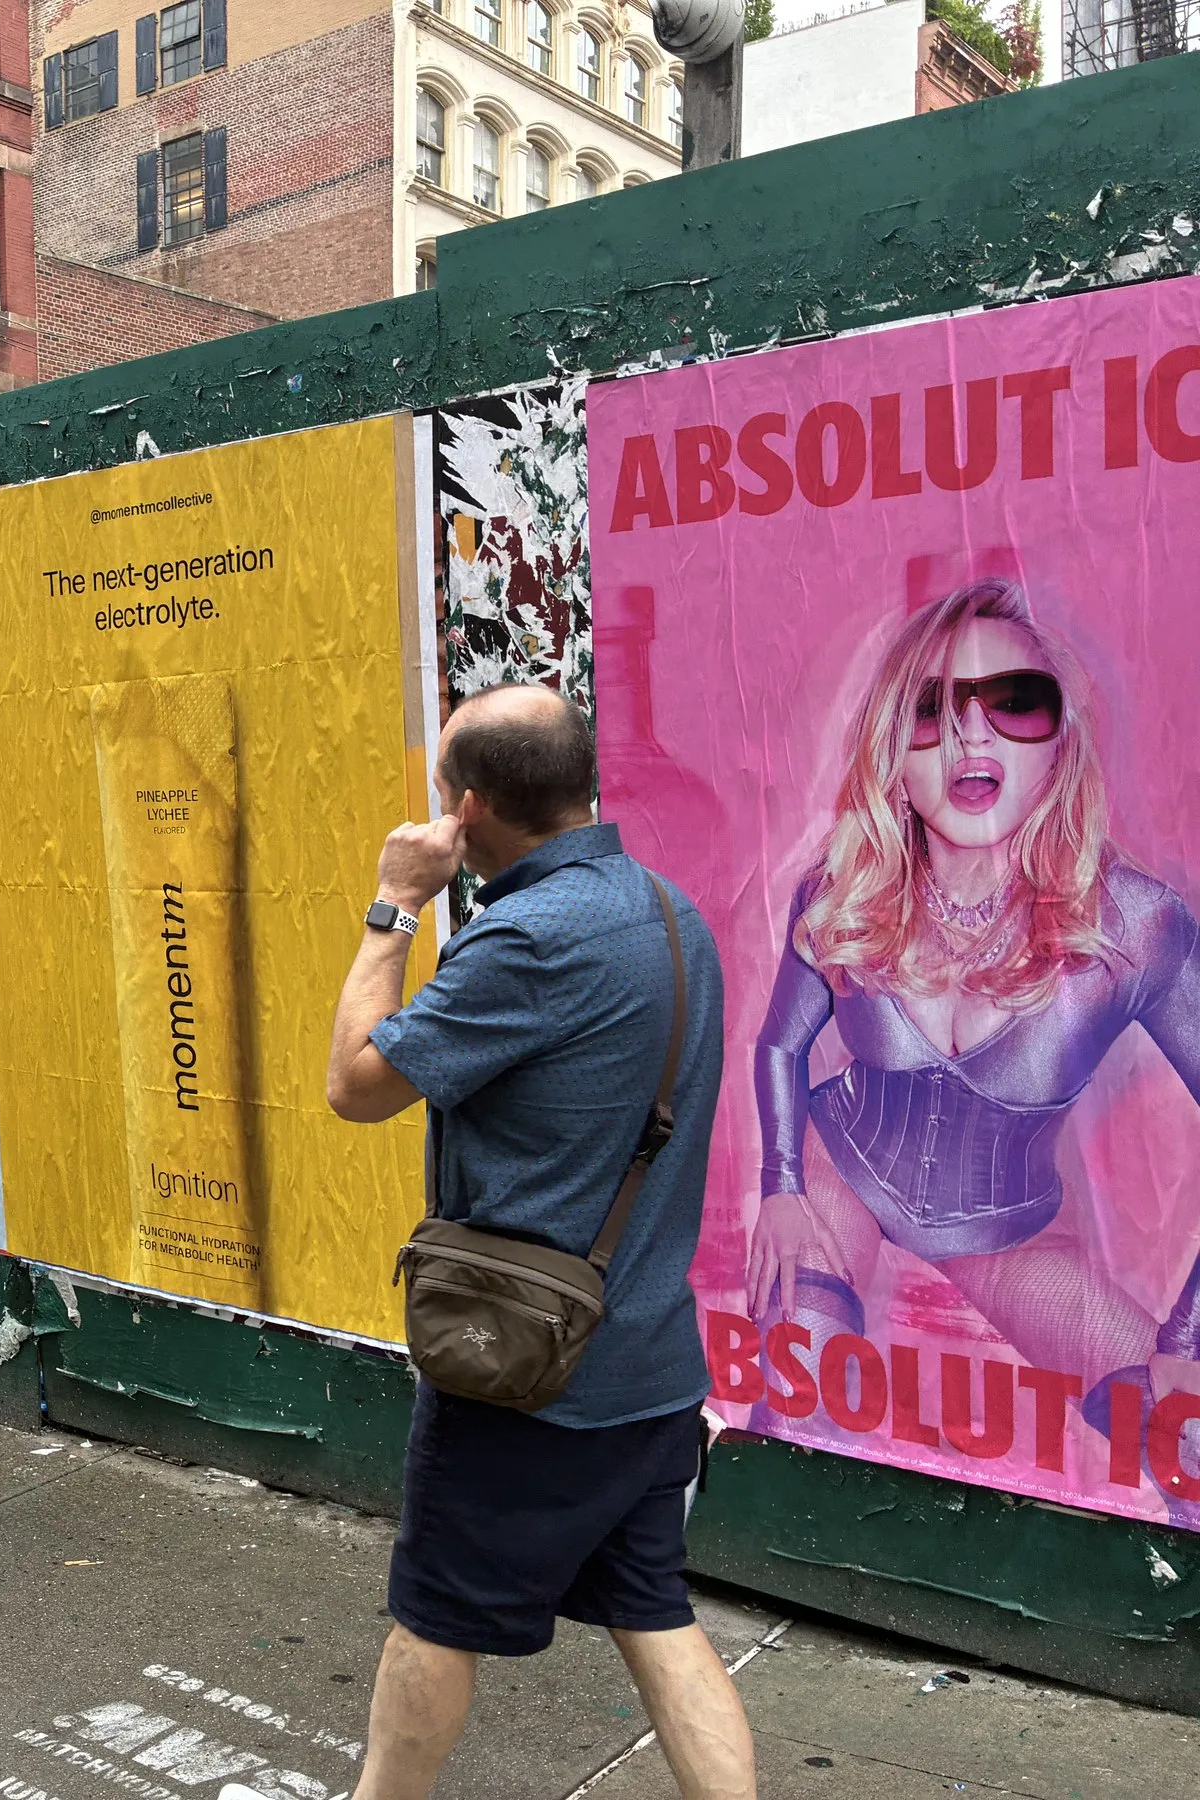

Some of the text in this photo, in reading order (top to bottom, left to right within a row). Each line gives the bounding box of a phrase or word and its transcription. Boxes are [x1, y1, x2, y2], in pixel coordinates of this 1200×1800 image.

[608, 366, 1071, 533] ABSOLUT
[90, 492, 213, 524] @momentmcollective
[43, 545, 274, 597] The next-generation
[95, 597, 220, 631] electrolyte.
[136, 789, 198, 802] PINEAPPLE
[147, 808, 190, 821] LYCHEE
[153, 826, 185, 834] FLAVORED
[161, 881, 200, 1111] momentm
[151, 1162, 239, 1204] Ignition
[139, 1224, 261, 1257] FUNCTIONAL HYDRATION
[139, 1239, 157, 1252] FOR
[159, 1245, 214, 1263] METABOLIC
[706, 1310, 1083, 1475] BSOLUT
[1020, 1481, 1037, 1491] From
[203, 1687, 364, 1761] BROAWA
